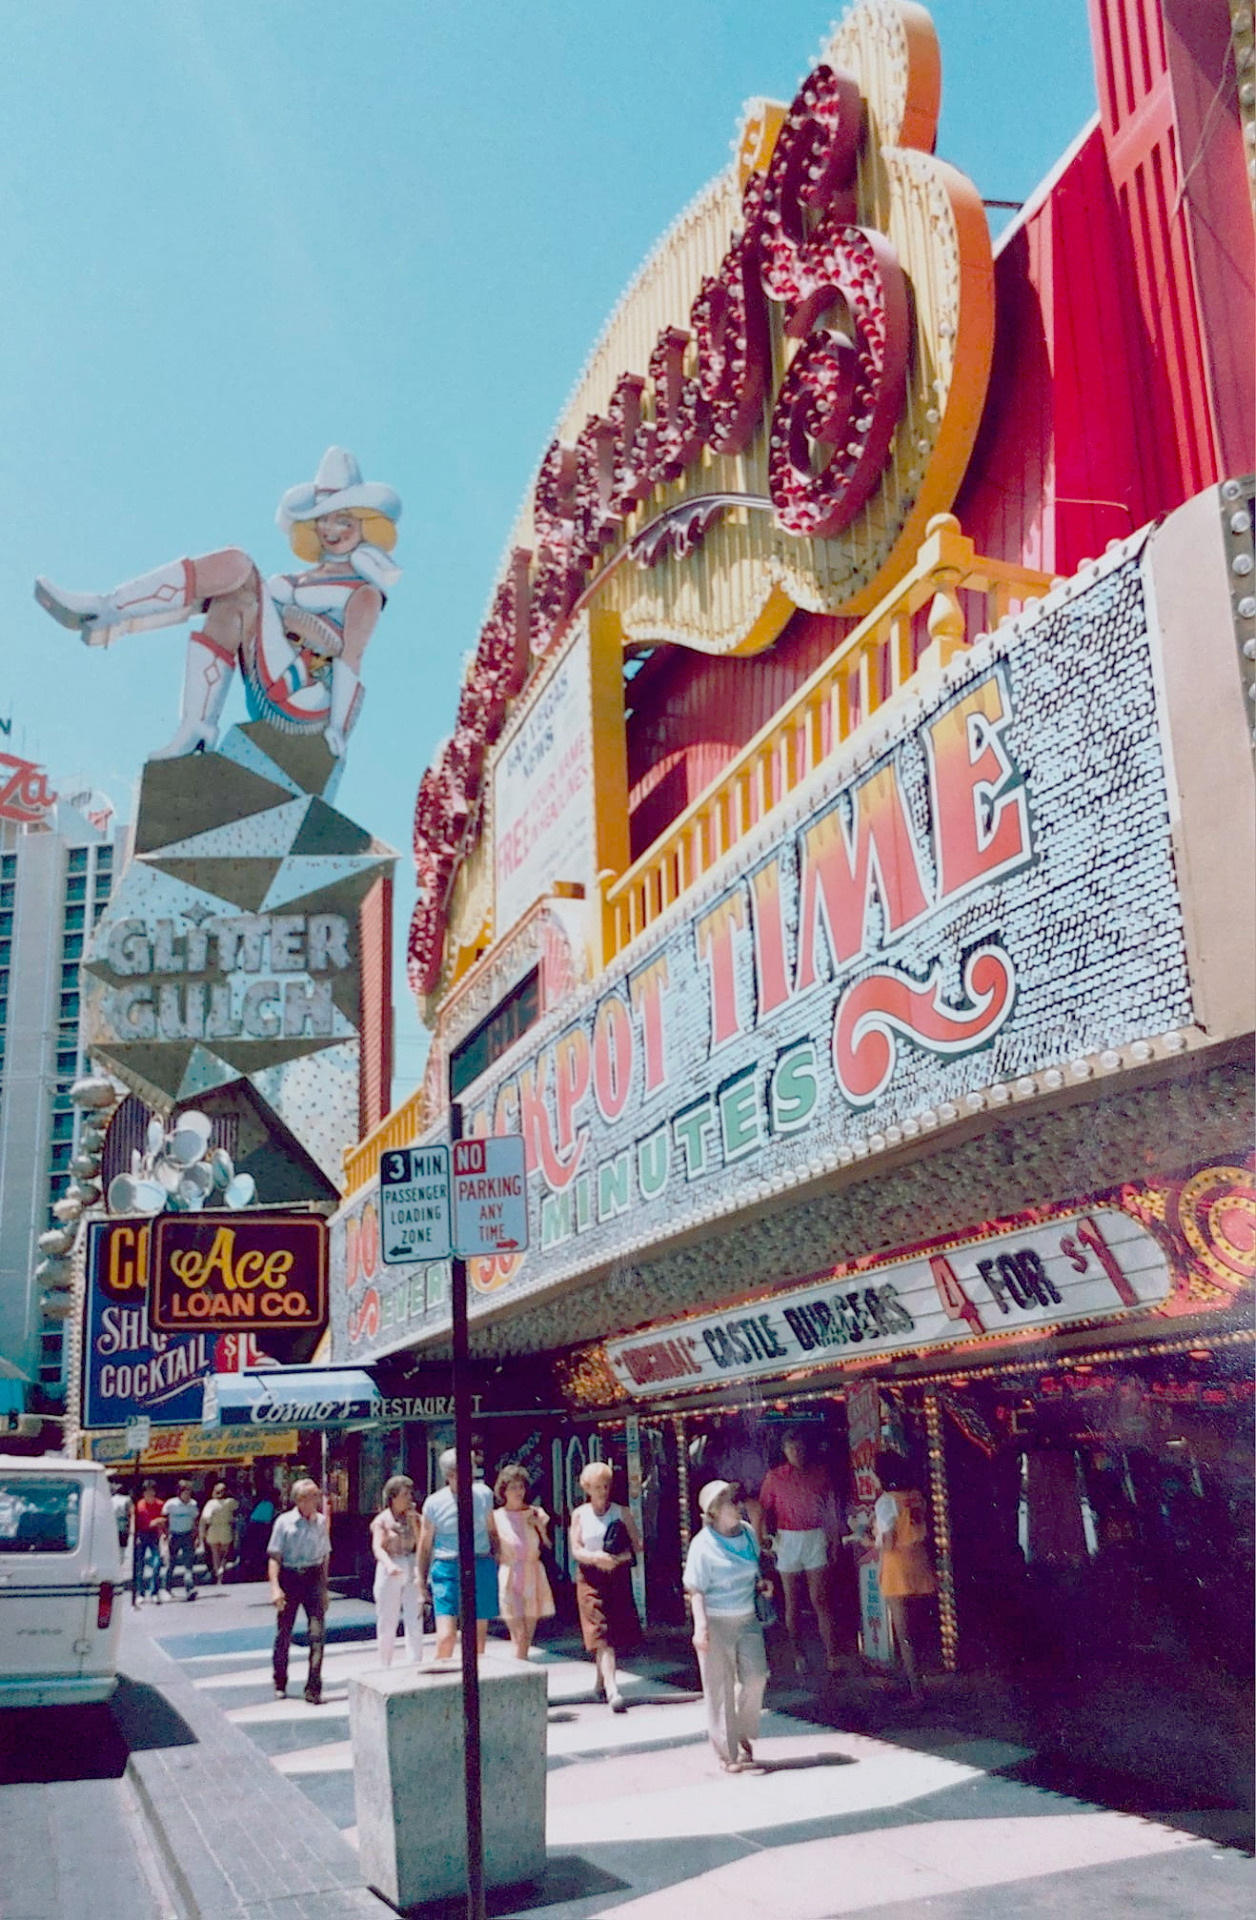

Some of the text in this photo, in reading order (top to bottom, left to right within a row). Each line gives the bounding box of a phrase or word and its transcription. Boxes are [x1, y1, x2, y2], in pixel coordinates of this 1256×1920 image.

[695, 674, 1034, 1056] TIME
[107, 912, 353, 977] GLITTER
[112, 980, 334, 1041] GULCH
[389, 1153, 447, 1180] 3 MIN.
[457, 1143, 483, 1173] NO
[380, 1040, 819, 1331] EVER MINUTES
[384, 1184, 447, 1205] PASSENGER
[458, 1174, 522, 1202] PARKING
[391, 1206, 442, 1226] LOADING
[479, 1203, 503, 1221] ANY
[401, 1227, 433, 1246] ZONE
[478, 1223, 506, 1243] TIME
[169, 1225, 294, 1291] Ace
[172, 1291, 313, 1318] LOAN CO.
[701, 1312, 788, 1370] CASTLE
[782, 1282, 916, 1353] BURGERS
[928, 1253, 986, 1336] 4
[976, 1248, 1063, 1315] FOR
[100, 1332, 211, 1399] COCKTAIL
[250, 1394, 483, 1425] Cosmo's RESTAURAT
